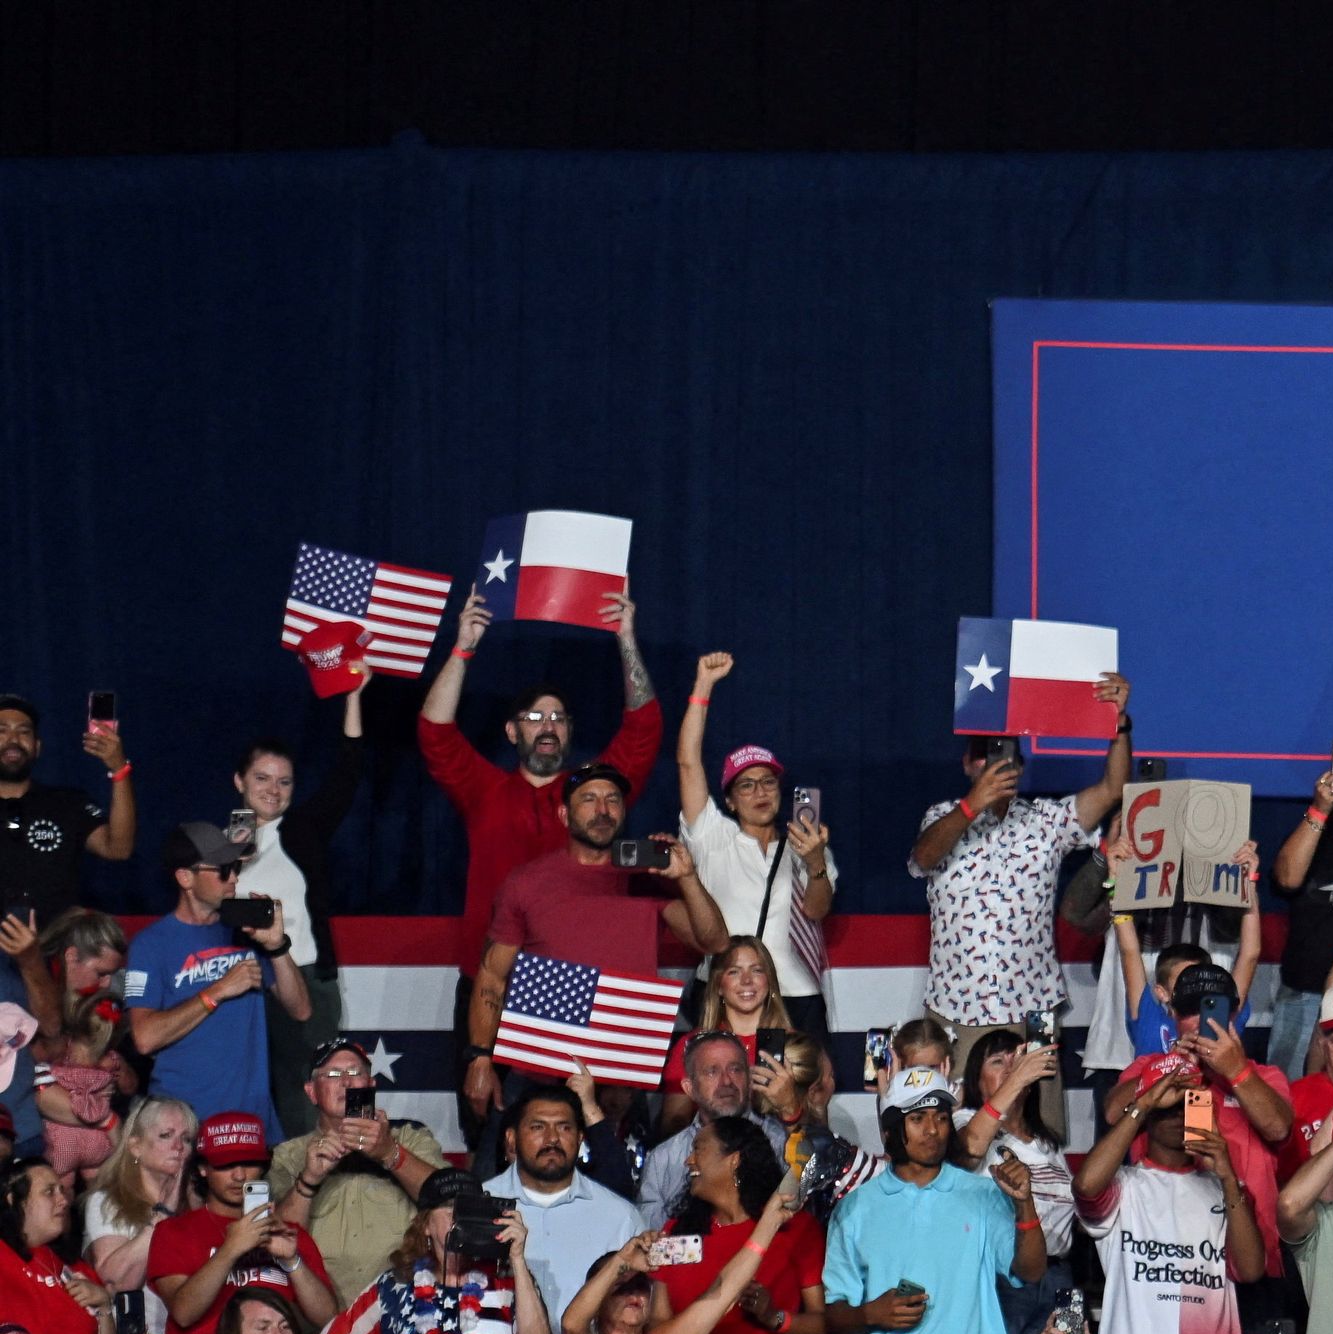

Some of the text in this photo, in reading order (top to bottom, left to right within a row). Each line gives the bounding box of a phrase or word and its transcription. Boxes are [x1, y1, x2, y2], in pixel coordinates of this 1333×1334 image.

[310, 644, 344, 662] TRUMP
[734, 757, 754, 767] GREAT
[1127, 780, 1239, 863] GO
[1133, 859, 1252, 900] TRUMP
[175, 951, 256, 988] AMERI
[904, 1069, 935, 1090] 47
[209, 1123, 262, 1136] MAKE AMERICA
[214, 1134, 260, 1146] GREAT AGAIN
[1120, 1230, 1194, 1260] Progress
[1134, 1259, 1224, 1290] Perfection
[1157, 1292, 1205, 1304] SANTO STUDIO
